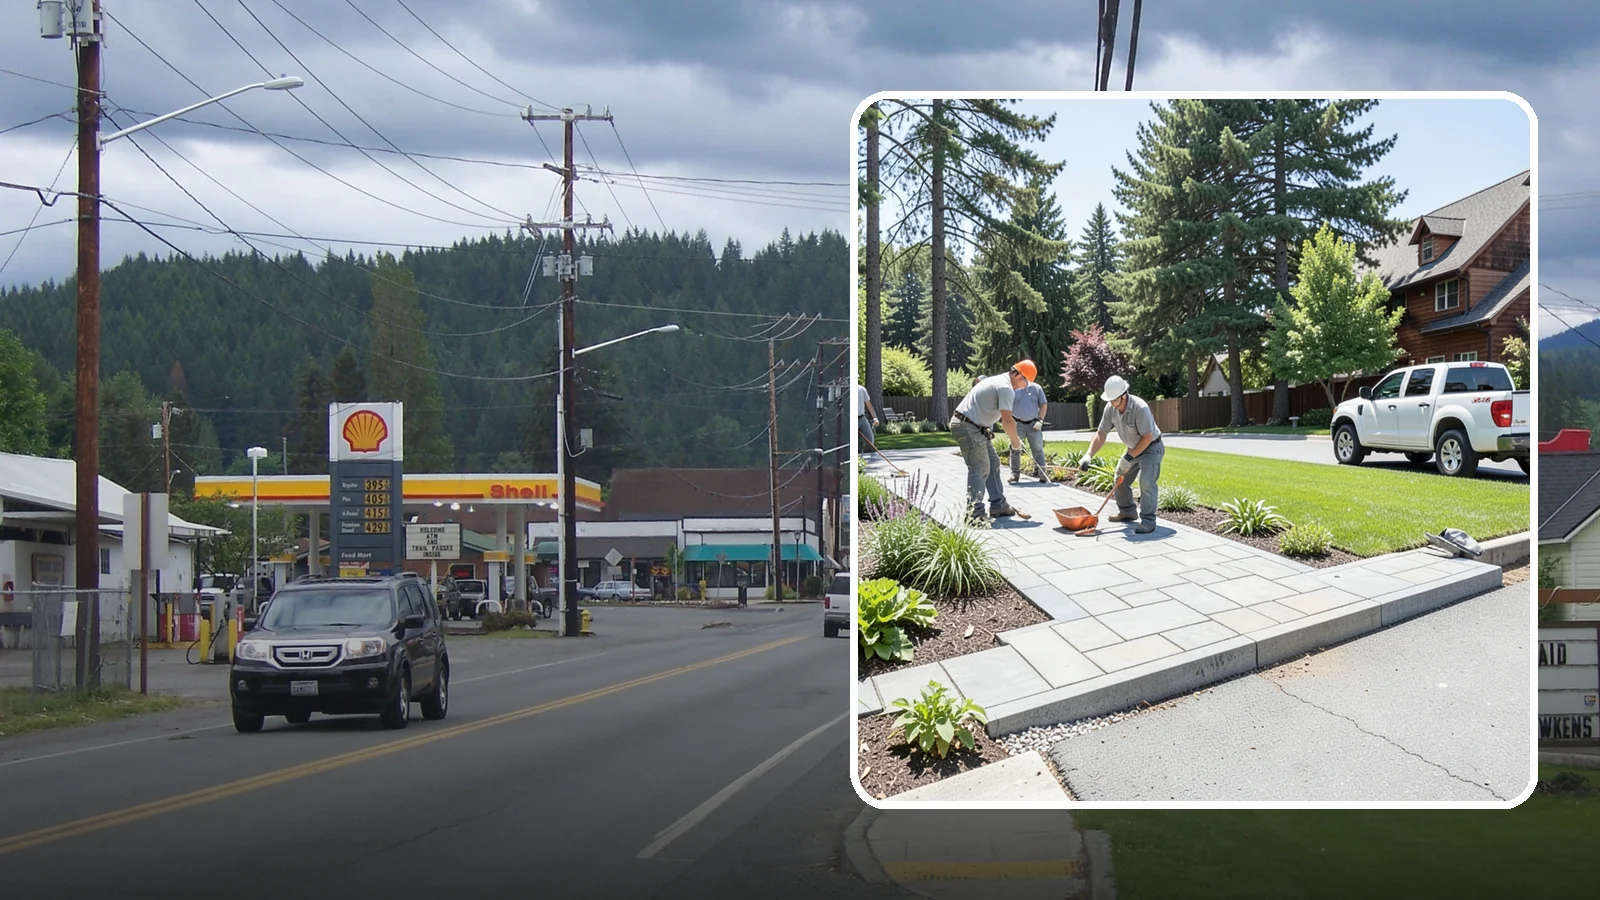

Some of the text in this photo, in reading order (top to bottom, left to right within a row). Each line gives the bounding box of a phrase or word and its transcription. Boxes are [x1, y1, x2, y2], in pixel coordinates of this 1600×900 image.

[366, 480, 383, 490] 395
[490, 484, 547, 499] Shell
[366, 494, 383, 504] 405
[366, 508, 383, 518] 415
[366, 522, 383, 532] 429
